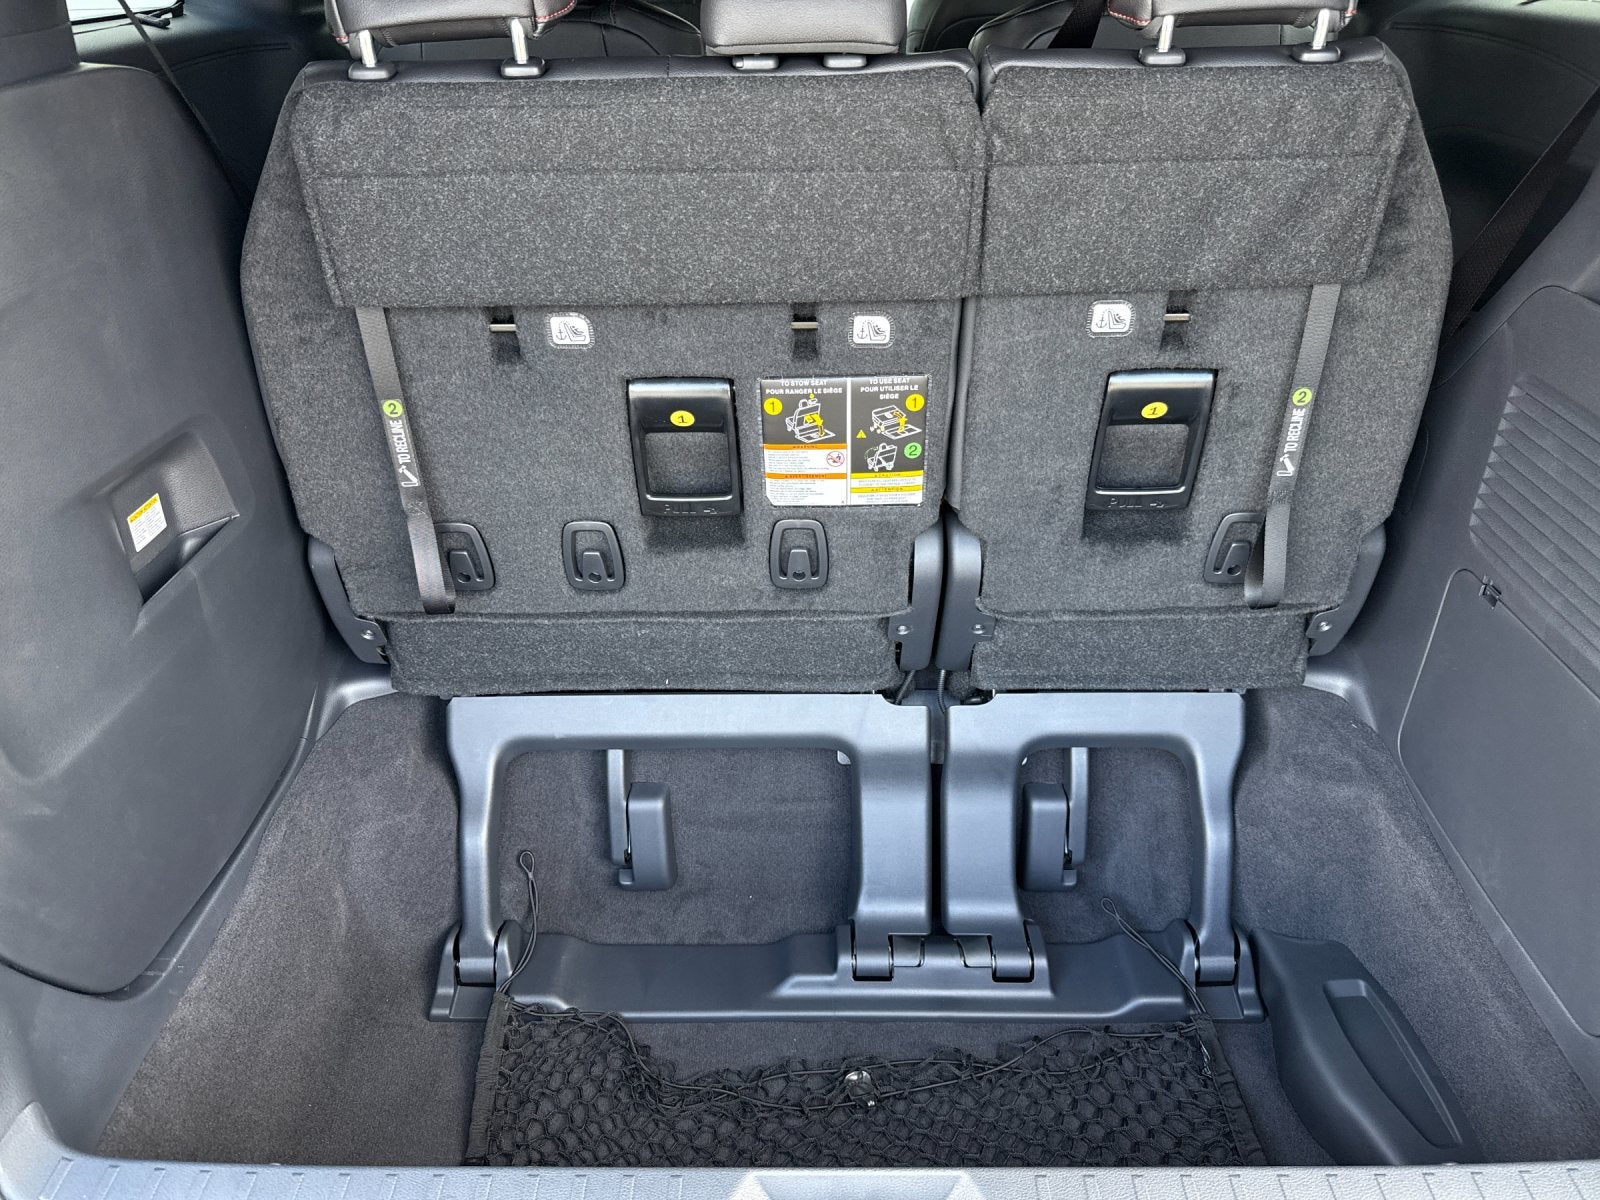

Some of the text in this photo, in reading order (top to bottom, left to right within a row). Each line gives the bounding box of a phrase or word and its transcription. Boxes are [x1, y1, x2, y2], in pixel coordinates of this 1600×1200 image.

[388, 402, 398, 414] 2
[1297, 390, 1307, 404] 2
[390, 420, 411, 464] TO RECLINE
[1284, 408, 1306, 453] TO RECLINE
